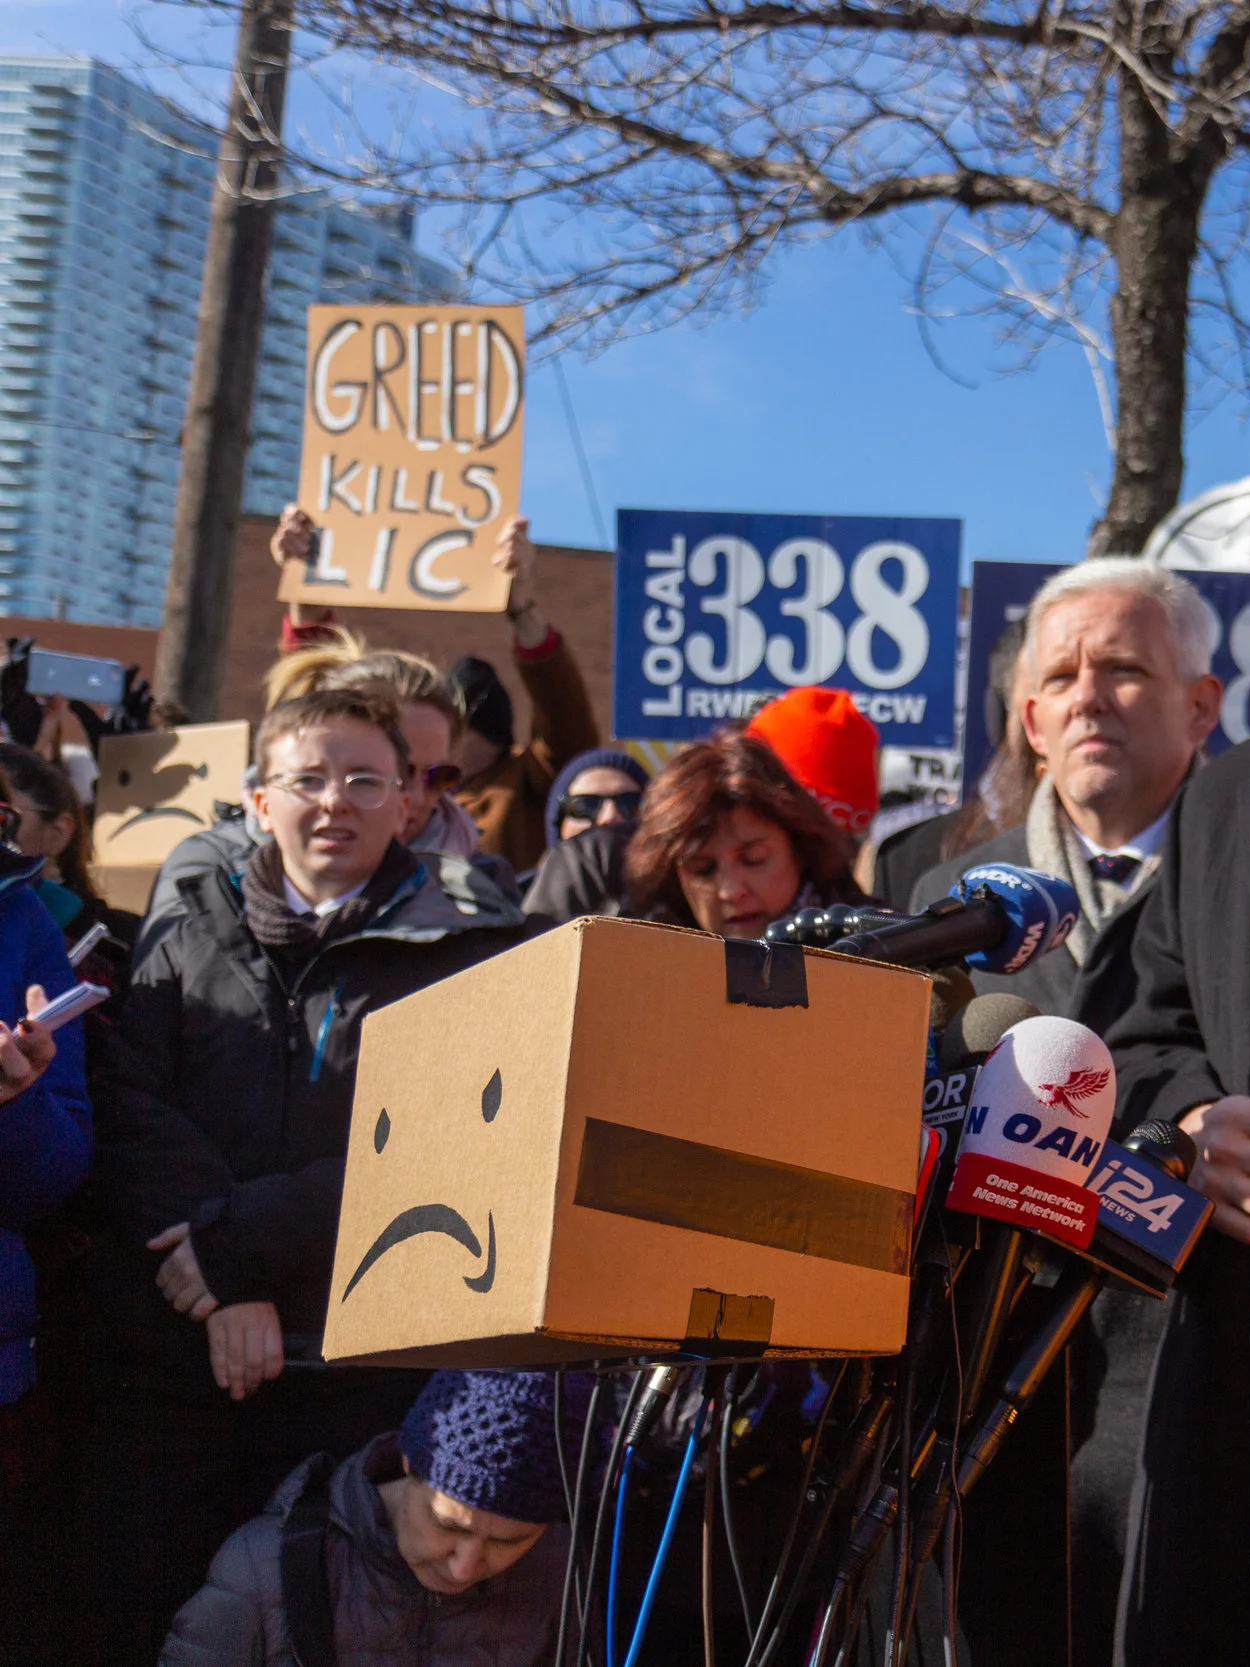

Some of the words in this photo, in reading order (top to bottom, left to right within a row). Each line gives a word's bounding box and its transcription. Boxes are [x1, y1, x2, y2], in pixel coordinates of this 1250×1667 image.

[312, 319, 523, 453] GREED
[318, 454, 502, 528] KILLS
[304, 527, 477, 600] LIC
[642, 534, 687, 718] LOCAL
[684, 534, 931, 690] 338
[923, 1073, 967, 1111] OR
[1002, 1112, 1101, 1168] OAN
[972, 1186, 1019, 1210] News
[1020, 1197, 1087, 1232] Network
[985, 1173, 1019, 1193] One
[1020, 1184, 1085, 1215] America
[1085, 1159, 1185, 1233] i24
[1099, 1193, 1136, 1223] NEWS
